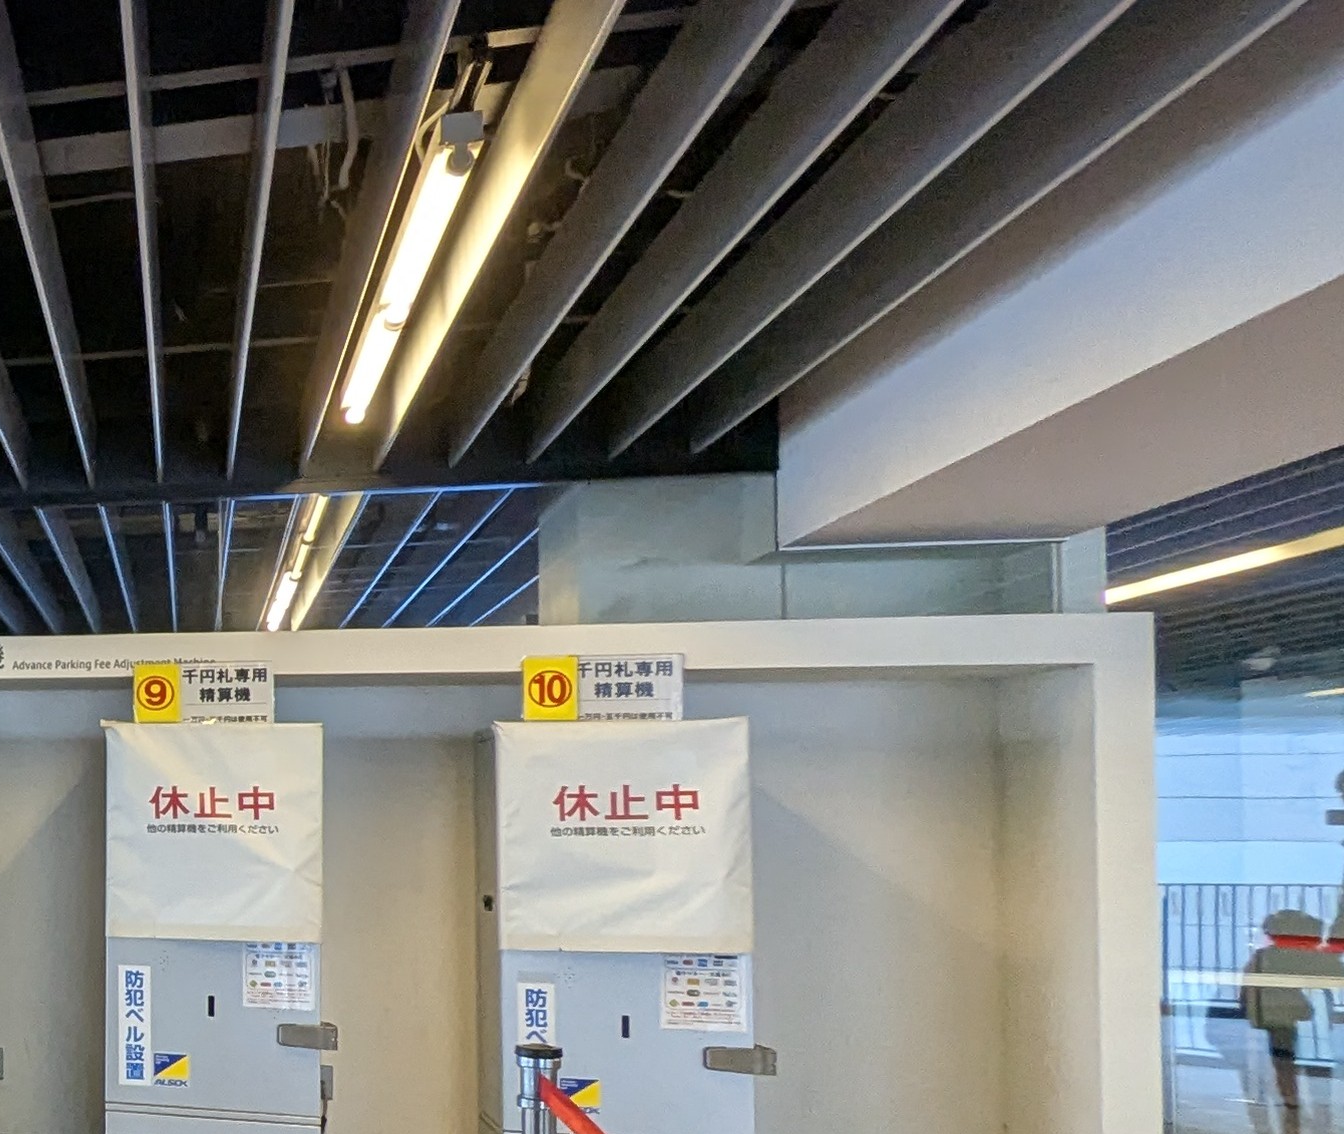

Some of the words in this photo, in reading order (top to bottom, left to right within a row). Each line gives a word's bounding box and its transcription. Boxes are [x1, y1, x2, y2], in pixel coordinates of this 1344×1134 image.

[12, 660, 53, 670] Advance
[55, 659, 92, 672] Parking
[95, 658, 113, 669] Fee
[578, 660, 674, 679] 千円札専用
[182, 667, 268, 684] 千円札専用
[199, 687, 251, 703] 精算機
[594, 681, 655, 698] 精算機
[148, 785, 275, 821] 休止中
[552, 783, 700, 822] 休止中
[146, 823, 279, 835] 他の精算機をご利用ください
[550, 825, 707, 838] 他の精算機をご利用ください
[524, 988, 548, 1044] 防犯ベ
[125, 970, 145, 1081] 防犯ベル設置
[153, 1078, 189, 1088] ALSOK
